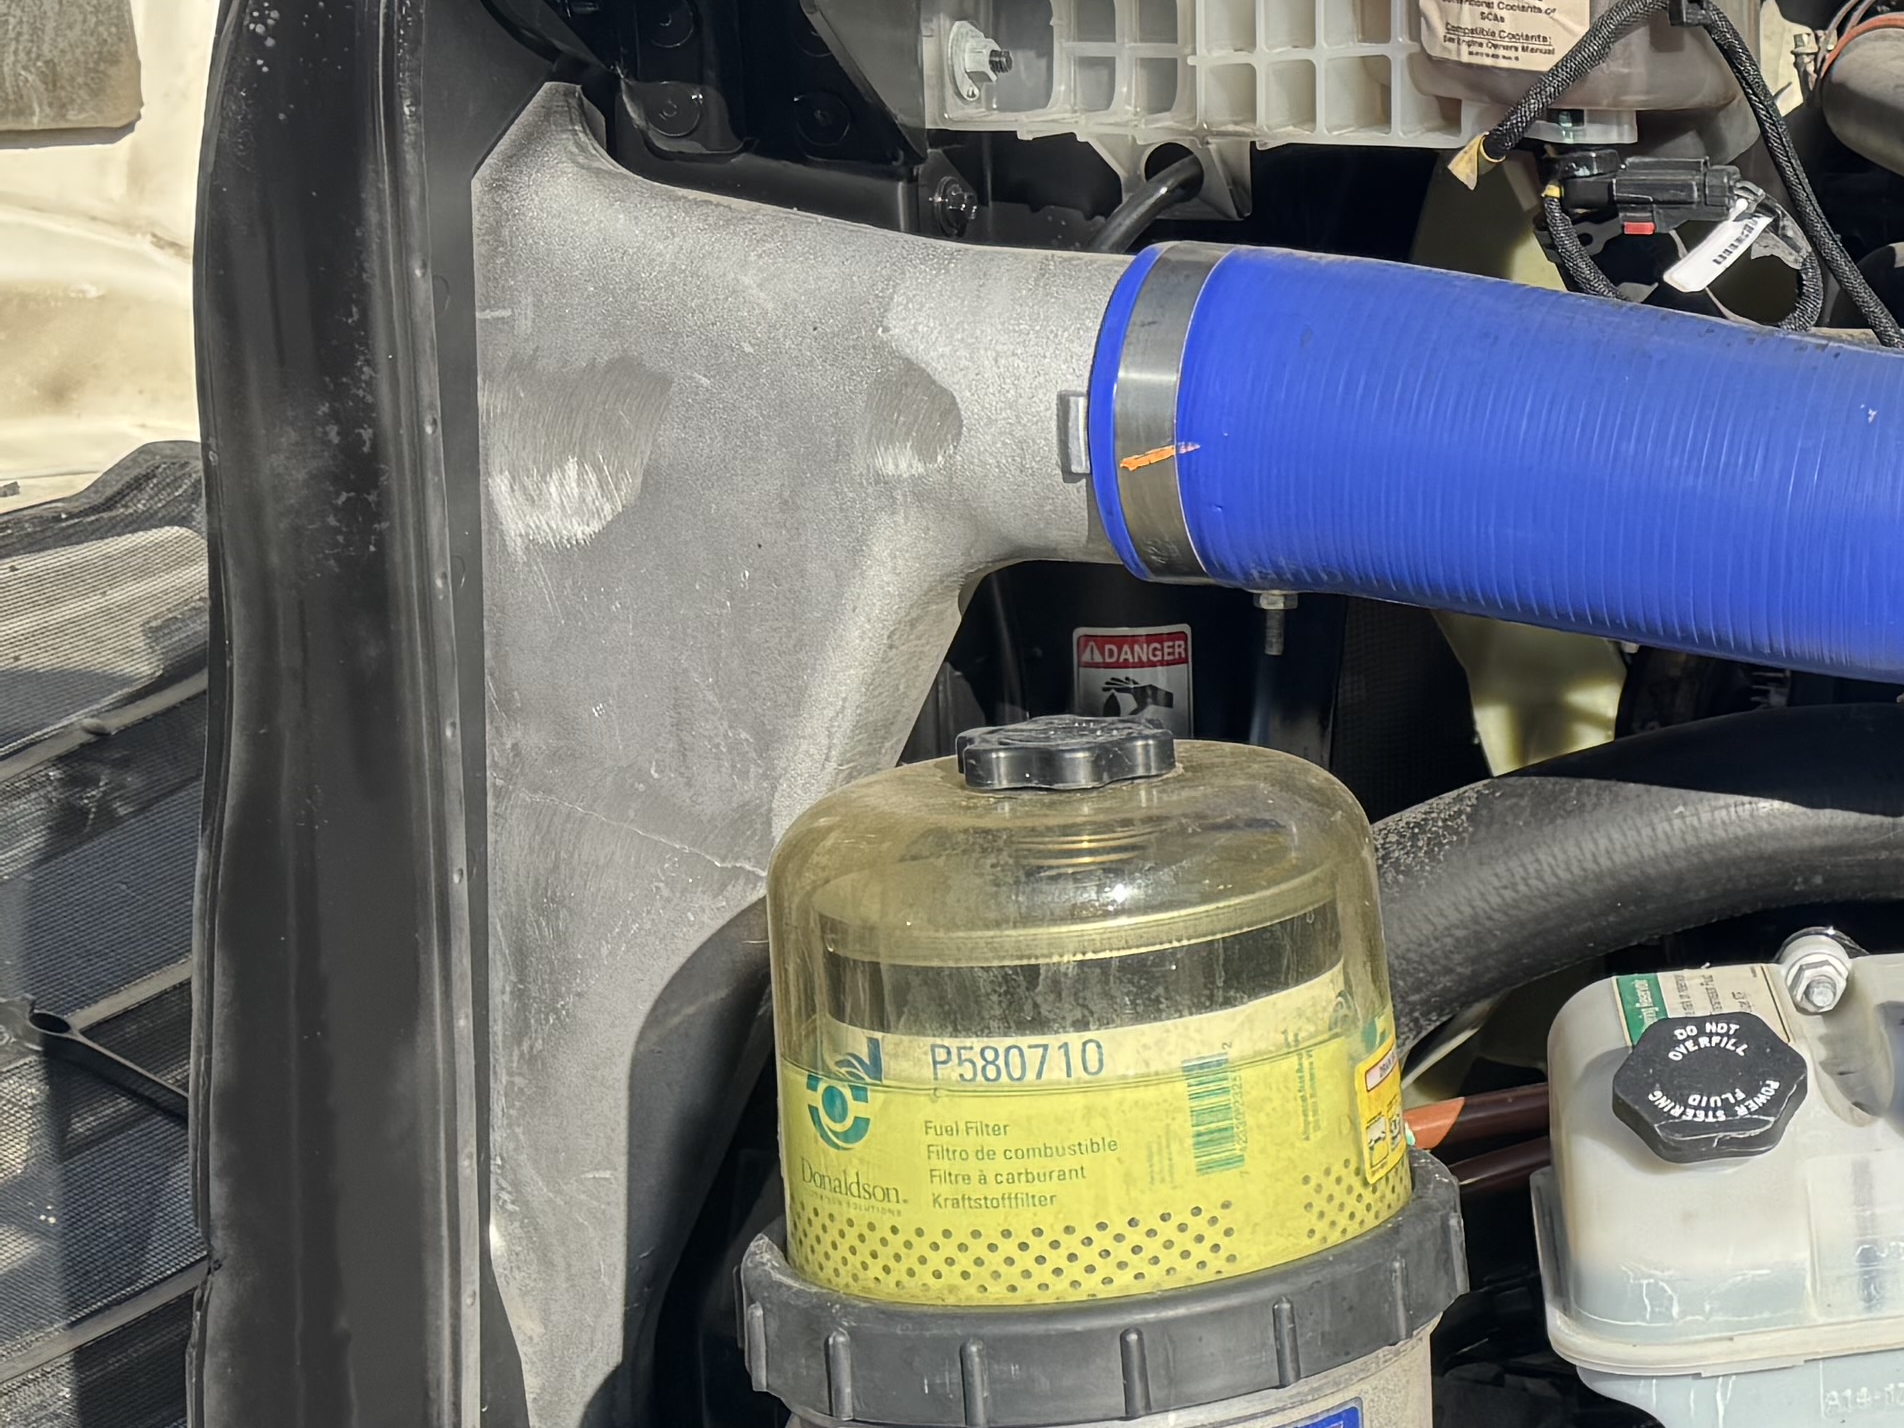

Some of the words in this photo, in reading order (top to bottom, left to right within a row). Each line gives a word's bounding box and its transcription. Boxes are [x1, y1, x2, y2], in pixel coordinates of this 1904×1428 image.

[1497, 2, 1542, 13] Coolants
[1104, 639, 1187, 664] DANGER
[1674, 1025, 1697, 1040] DO
[1706, 1022, 1740, 1033] NOT
[930, 1038, 1105, 1084] P580710
[1668, 1036, 1750, 1062] OVERFILL
[1648, 1091, 1726, 1122] STEERING
[1688, 1088, 1746, 1108] FLUID
[1735, 1080, 1780, 1115] POWER
[924, 1120, 959, 1137] Fuel
[965, 1120, 1009, 1137] Filter
[927, 1144, 969, 1161] Filtro
[976, 1145, 996, 1161] de
[1003, 1137, 1119, 1160] combustible
[801, 1155, 900, 1205] Donaldson
[930, 1168, 971, 1186] Filtre
[977, 1168, 988, 1184] à
[994, 1166, 1086, 1185] carburant
[932, 1193, 1058, 1210] Kraftstofffilter
